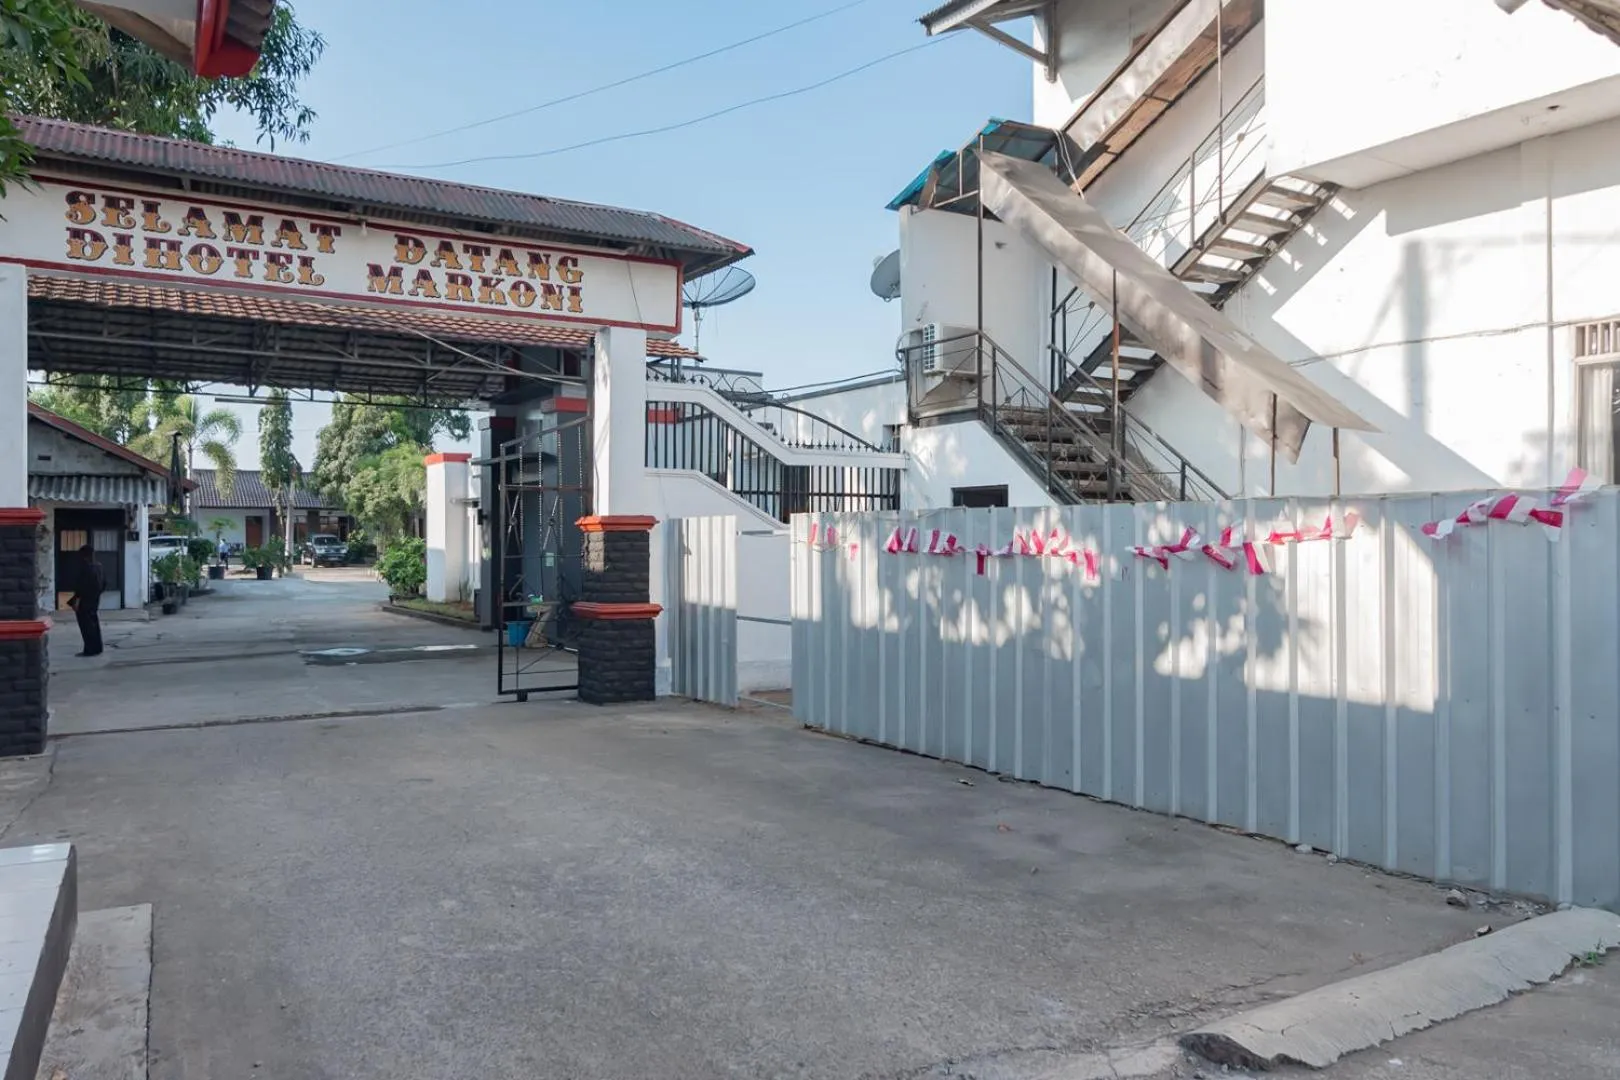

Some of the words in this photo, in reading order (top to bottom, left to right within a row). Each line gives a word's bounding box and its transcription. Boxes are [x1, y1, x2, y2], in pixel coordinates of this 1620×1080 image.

[65, 190, 341, 254] SELAMAT
[394, 233, 584, 284] DATANG
[366, 262, 584, 314] MARKONI
